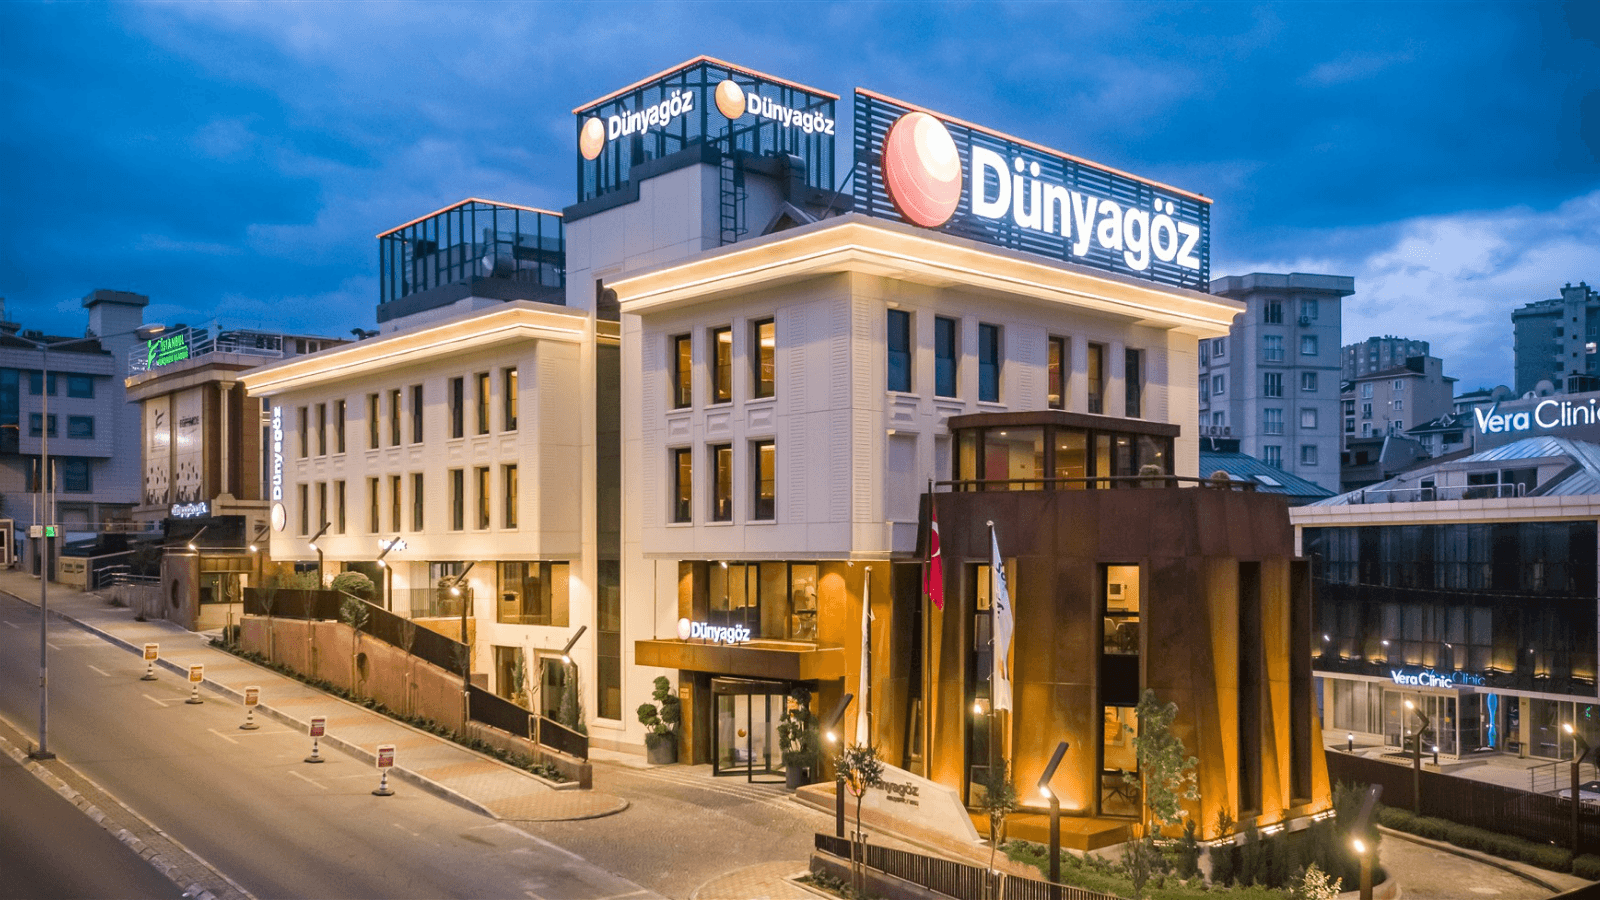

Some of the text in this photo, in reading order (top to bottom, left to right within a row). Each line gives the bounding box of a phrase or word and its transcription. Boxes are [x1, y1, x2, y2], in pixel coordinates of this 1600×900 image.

[608, 90, 693, 141] Dünyagöz
[747, 93, 835, 135] Dünyagöz
[971, 145, 1200, 271] Dünyagöz
[1474, 398, 1600, 434] Vera Clini
[272, 406, 283, 501] Dünyagöz
[691, 621, 751, 644] Dünyagöz
[1391, 669, 1418, 684] Vera
[1418, 672, 1453, 689] Clinic
